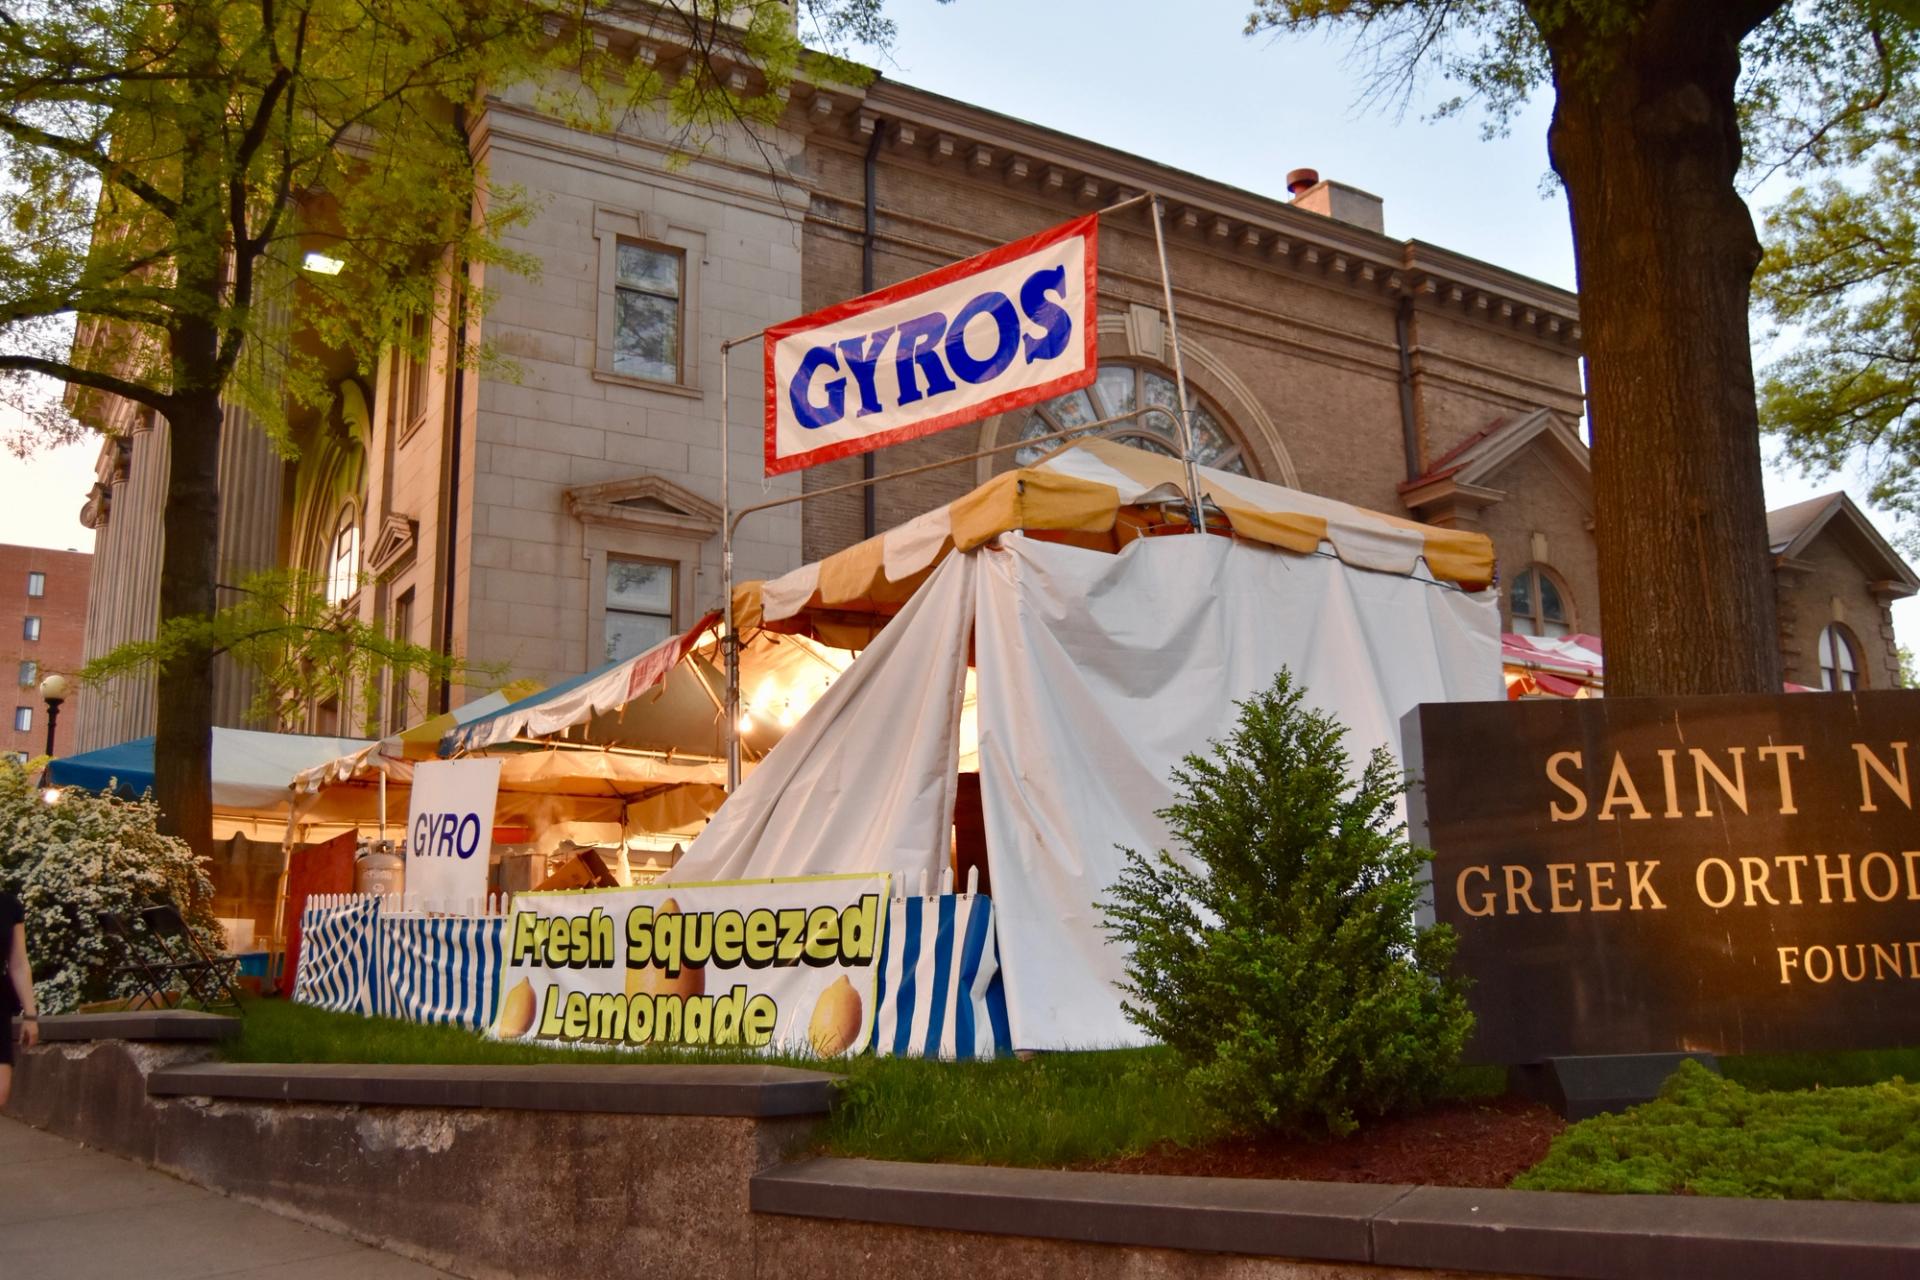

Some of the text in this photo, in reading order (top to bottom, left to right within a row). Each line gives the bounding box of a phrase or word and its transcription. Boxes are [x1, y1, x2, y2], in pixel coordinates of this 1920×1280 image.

[789, 264, 1072, 429] GYROS
[1545, 741, 1912, 822] SAINT N
[413, 812, 481, 860] GYRO
[1456, 859, 1667, 917] GREEK
[510, 893, 880, 979] Fresh Squeezed
[535, 984, 778, 1048] Lemonade
